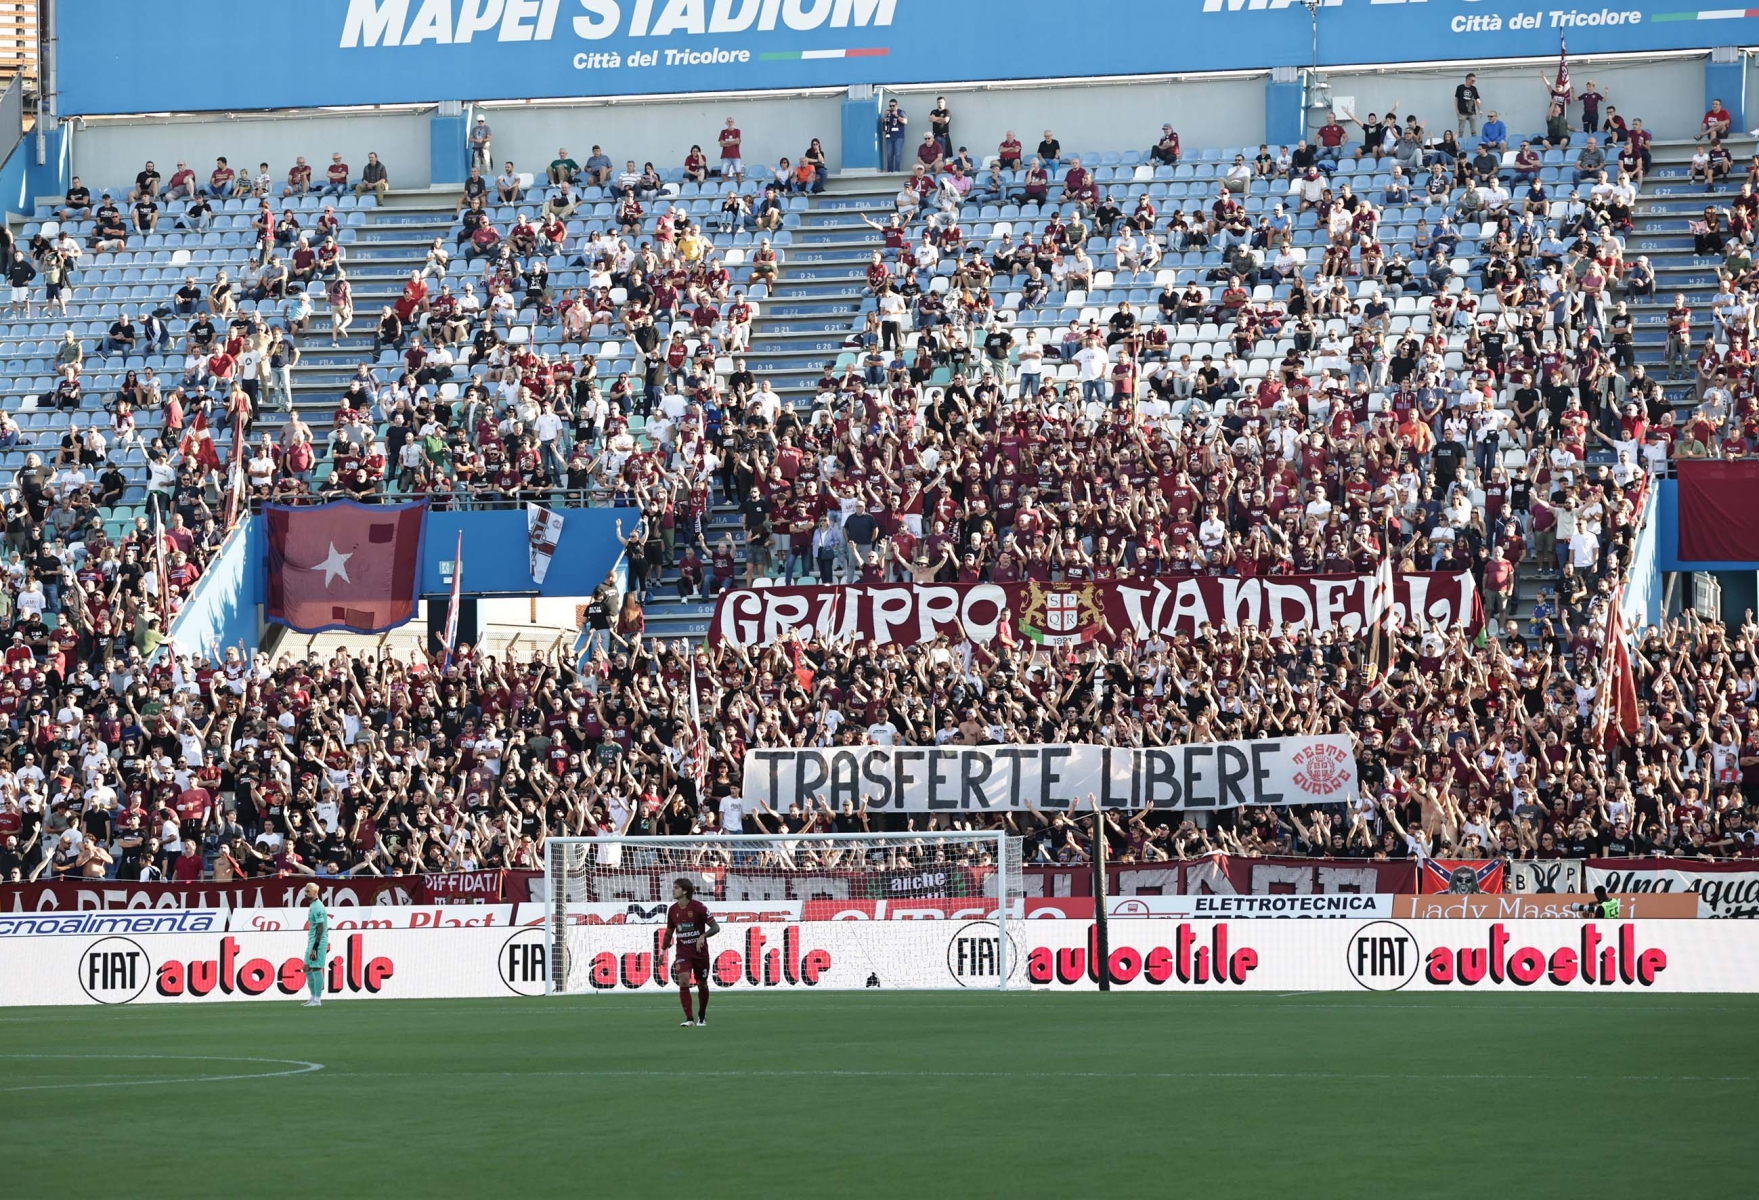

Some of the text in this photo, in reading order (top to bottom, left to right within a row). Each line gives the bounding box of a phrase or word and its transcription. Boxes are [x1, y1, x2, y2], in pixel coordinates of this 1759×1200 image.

[339, 0, 900, 48] MAPEI STADIUM
[1451, 9, 1642, 33] Città del Tricolore
[573, 47, 750, 70] Città del Tricolore
[1050, 596, 1074, 606] S P
[720, 584, 1008, 648] GRUPPO
[1049, 614, 1075, 626] Q R
[1292, 743, 1348, 766] TESTE
[754, 743, 1284, 810] TRASFERTE LIBERE
[1292, 769, 1352, 796] QUADRE
[425, 873, 498, 892] DIFFIDATI
[891, 872, 945, 891] anche
[1195, 897, 1376, 912] ELETTROTECNICA
[156, 934, 394, 998] autosile
[509, 944, 546, 982] FIA
[1357, 937, 1408, 976] FIAT
[1425, 923, 1666, 986] autostile
[89, 952, 140, 990] FIAT
